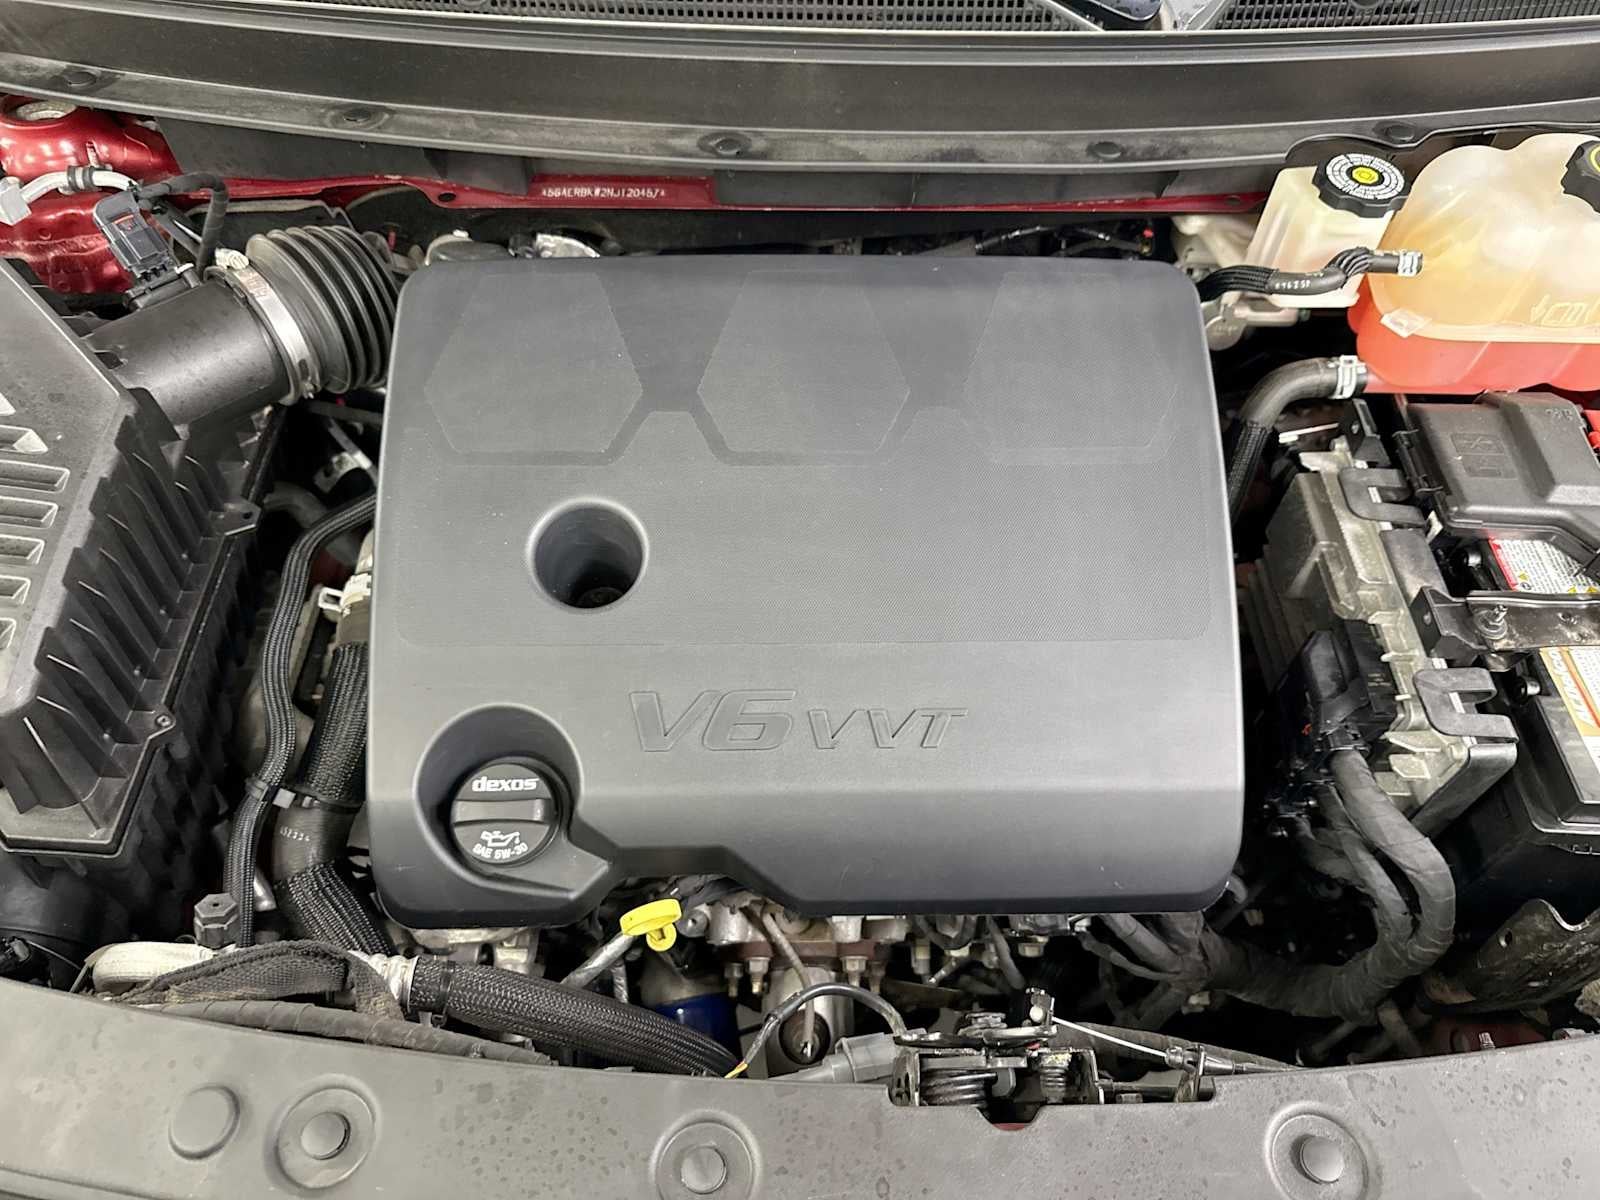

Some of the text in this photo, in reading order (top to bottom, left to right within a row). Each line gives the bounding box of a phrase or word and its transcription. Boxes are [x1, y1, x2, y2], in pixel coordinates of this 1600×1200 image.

[629, 689, 968, 752] V6 VVT
[471, 776, 540, 792] dexos
[472, 843, 529, 860] SAE 5W-30
